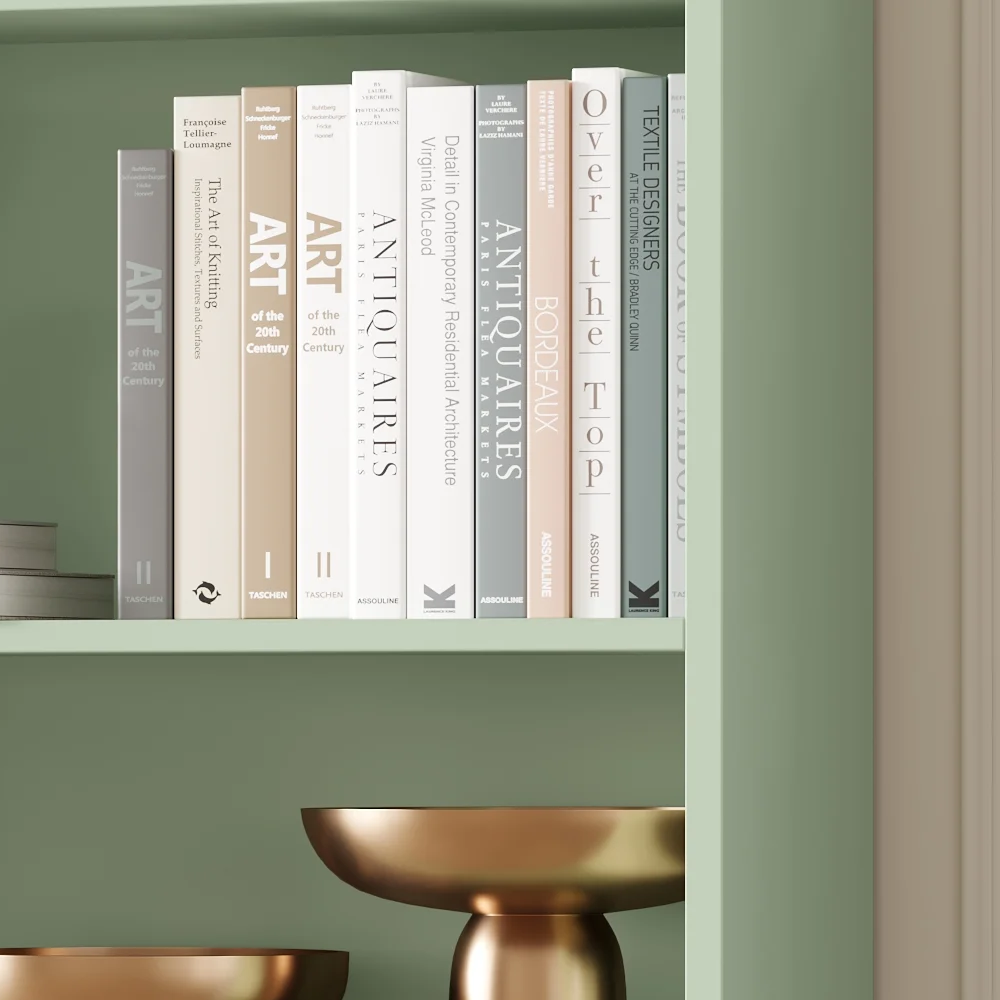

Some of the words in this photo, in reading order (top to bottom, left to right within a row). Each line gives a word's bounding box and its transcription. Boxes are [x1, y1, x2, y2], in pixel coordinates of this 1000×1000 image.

[183, 118, 227, 128] Françoise
[183, 129, 217, 138] Tellier-
[642, 105, 660, 172] TEXTILE
[183, 141, 232, 150] Loumagne
[444, 135, 460, 177] Detail
[417, 137, 436, 192] Virginia
[629, 172, 640, 185] AT
[192, 178, 203, 231] Inspirational
[209, 177, 222, 204] The
[444, 182, 460, 195] in
[629, 188, 640, 204] THE
[209, 208, 222, 231] Art
[421, 197, 436, 256] McLeod
[629, 207, 640, 245] CUTTING
[642, 178, 660, 271] DESIGNERS
[194, 232, 203, 267] Stitches,
[209, 234, 222, 249] of
[250, 211, 287, 295] ART
[306, 211, 342, 293] ART
[357, 212, 365, 279] PARIS
[441, 200, 460, 305] Contemporary
[481, 221, 490, 287] PARIS
[629, 246, 640, 271] EDGE
[126, 260, 162, 333] ART
[194, 269, 203, 305] Textures
[204, 253, 222, 309] Knitting
[629, 279, 640, 320] BRADLEY
[194, 306, 203, 322] and
[251, 310, 264, 322] of
[266, 310, 284, 321] the
[255, 326, 280, 338] 20th
[307, 310, 320, 320] of
[322, 310, 340, 320] the
[312, 326, 336, 336] 20th
[357, 299, 365, 350] FLEA
[481, 306, 490, 357] FLEA
[128, 347, 140, 358] of
[142, 347, 160, 358] the
[194, 324, 203, 360] Surfaces
[246, 342, 289, 356] Century
[302, 342, 345, 355] Century
[366, 209, 398, 478] ANTIQUAIRES
[444, 311, 460, 392] Residential
[489, 219, 522, 480] ANTIQUAIRES
[629, 322, 640, 352] QUINN
[122, 376, 165, 387] Century
[131, 361, 156, 371] 20th
[534, 296, 559, 433] BORDEAUX
[357, 372, 365, 476] MARKETS
[444, 397, 460, 486] Architecture
[481, 376, 490, 478] MARKETS
[540, 531, 552, 598] ASSOULINE
[589, 533, 600, 598] ASSOULINE
[248, 591, 288, 599] TASCHEN
[305, 591, 344, 599] TASCHEN
